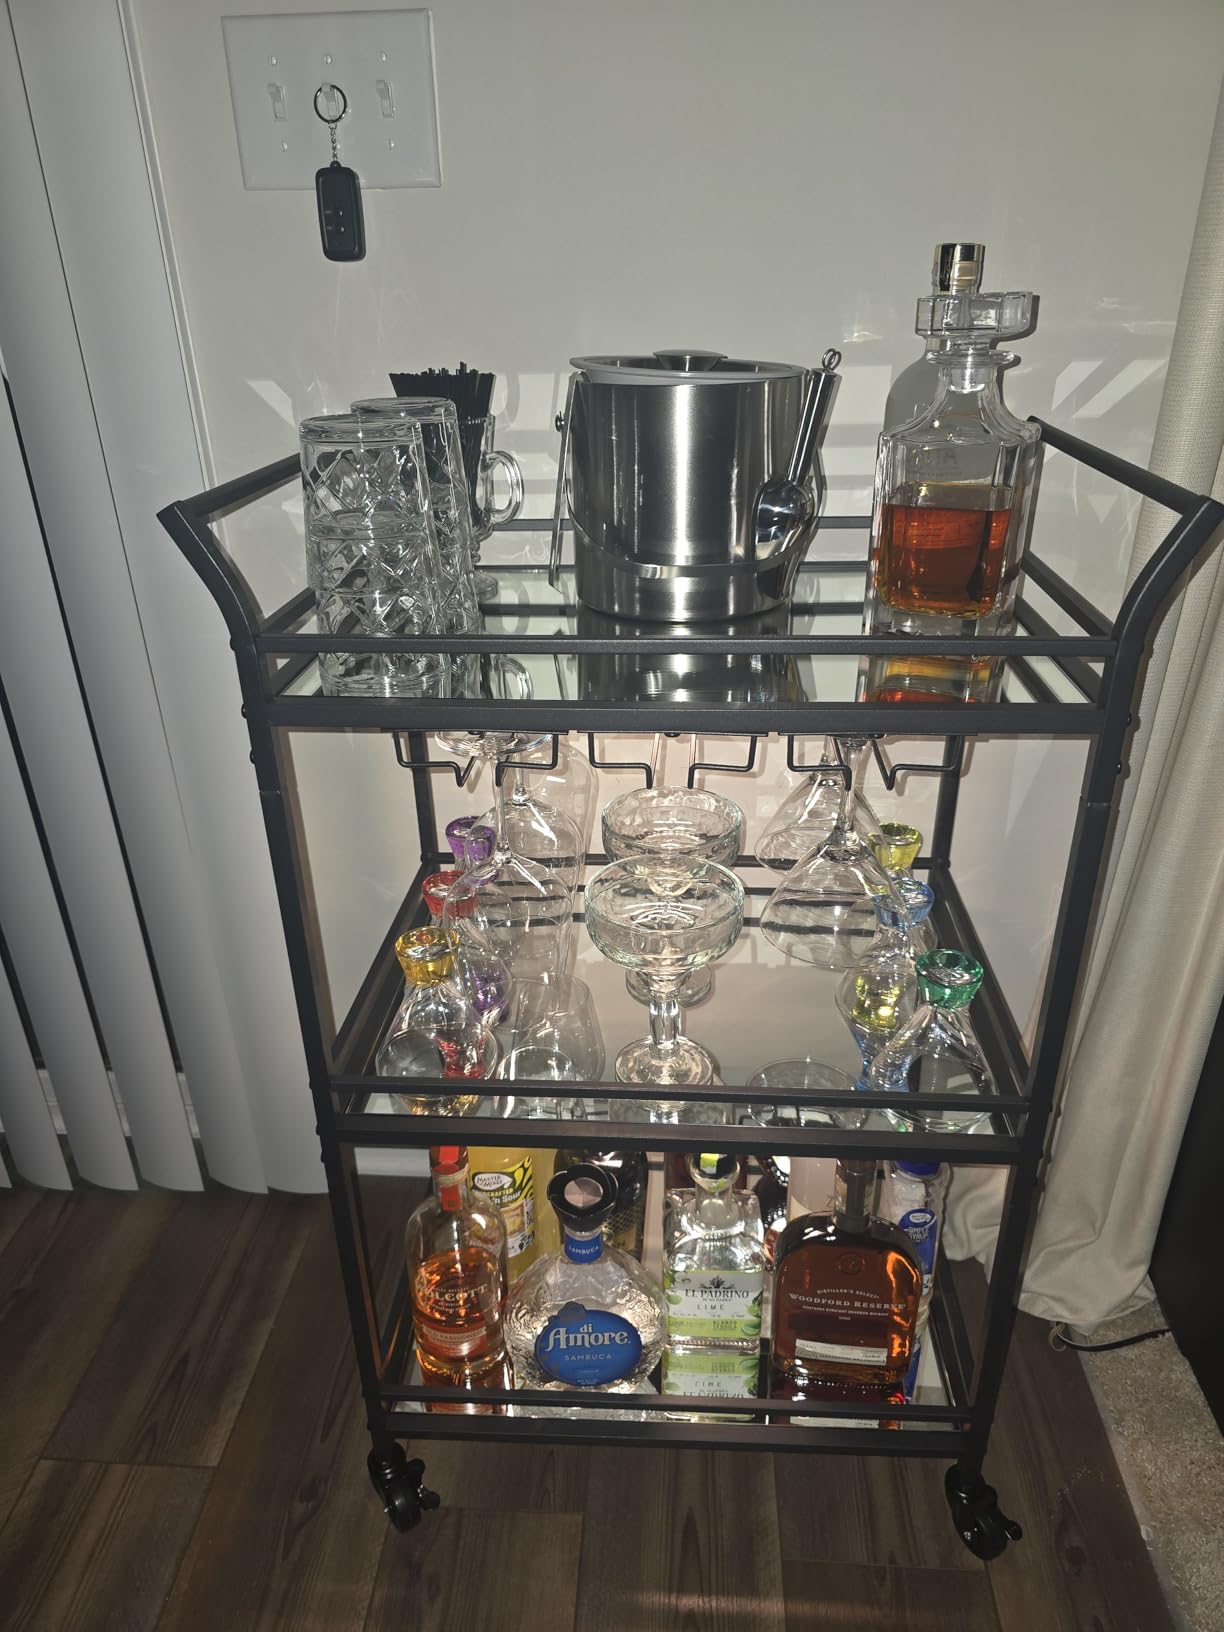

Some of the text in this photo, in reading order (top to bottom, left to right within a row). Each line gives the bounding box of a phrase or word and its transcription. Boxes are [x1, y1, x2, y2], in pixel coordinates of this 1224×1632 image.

[502, 1190, 522, 1203] Sour
[685, 1288, 749, 1299] EL PADRINO
[789, 1293, 904, 1310] WOODFORD RESERVE
[580, 1324, 592, 1333] di
[545, 1327, 628, 1352] Amore
